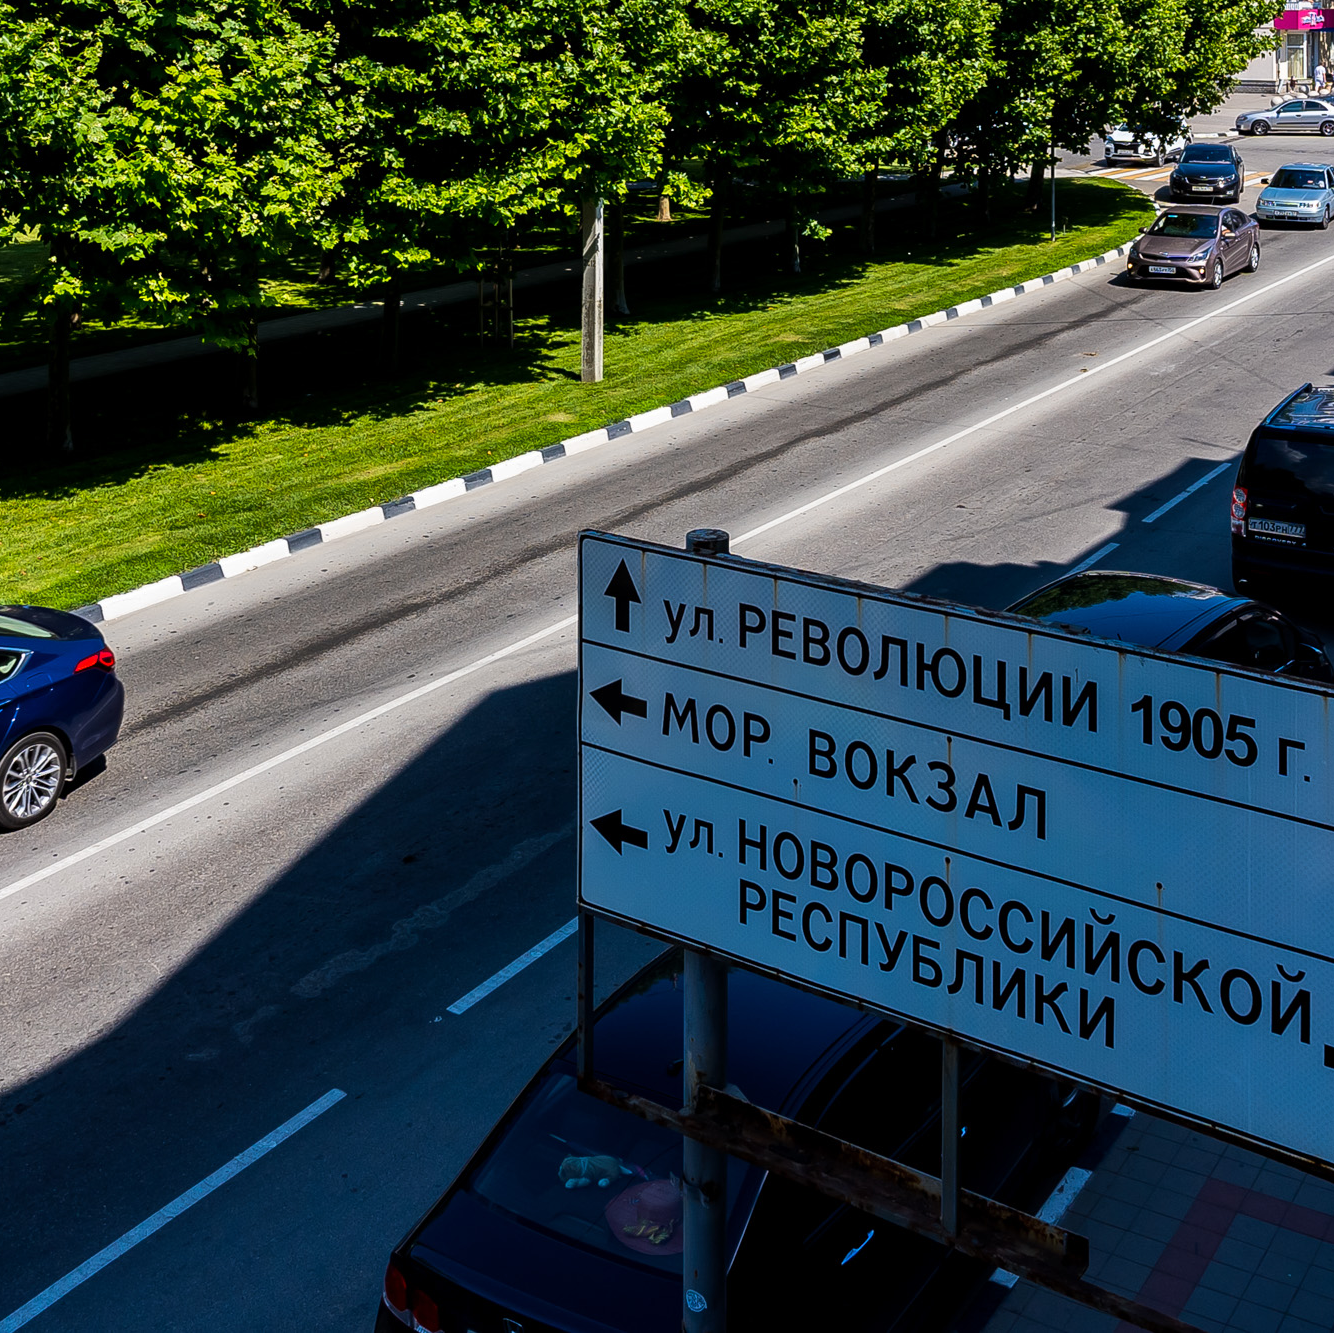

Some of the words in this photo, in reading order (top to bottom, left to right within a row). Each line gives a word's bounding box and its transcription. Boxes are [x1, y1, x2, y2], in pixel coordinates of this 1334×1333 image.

[662, 693, 775, 765] МОР.
[809, 729, 1046, 840] ВОКЗАЛ
[663, 600, 727, 644] ул.
[739, 603, 1097, 732] РЕВОЛЮЦИИ
[1132, 695, 1257, 767] 1905
[1278, 738, 1315, 785] г.
[663, 809, 725, 856] ул.
[739, 819, 1311, 1044] НОВОРОССИЙСКОЙ
[740, 879, 1115, 1048] РЕСПУБЛИКИ
